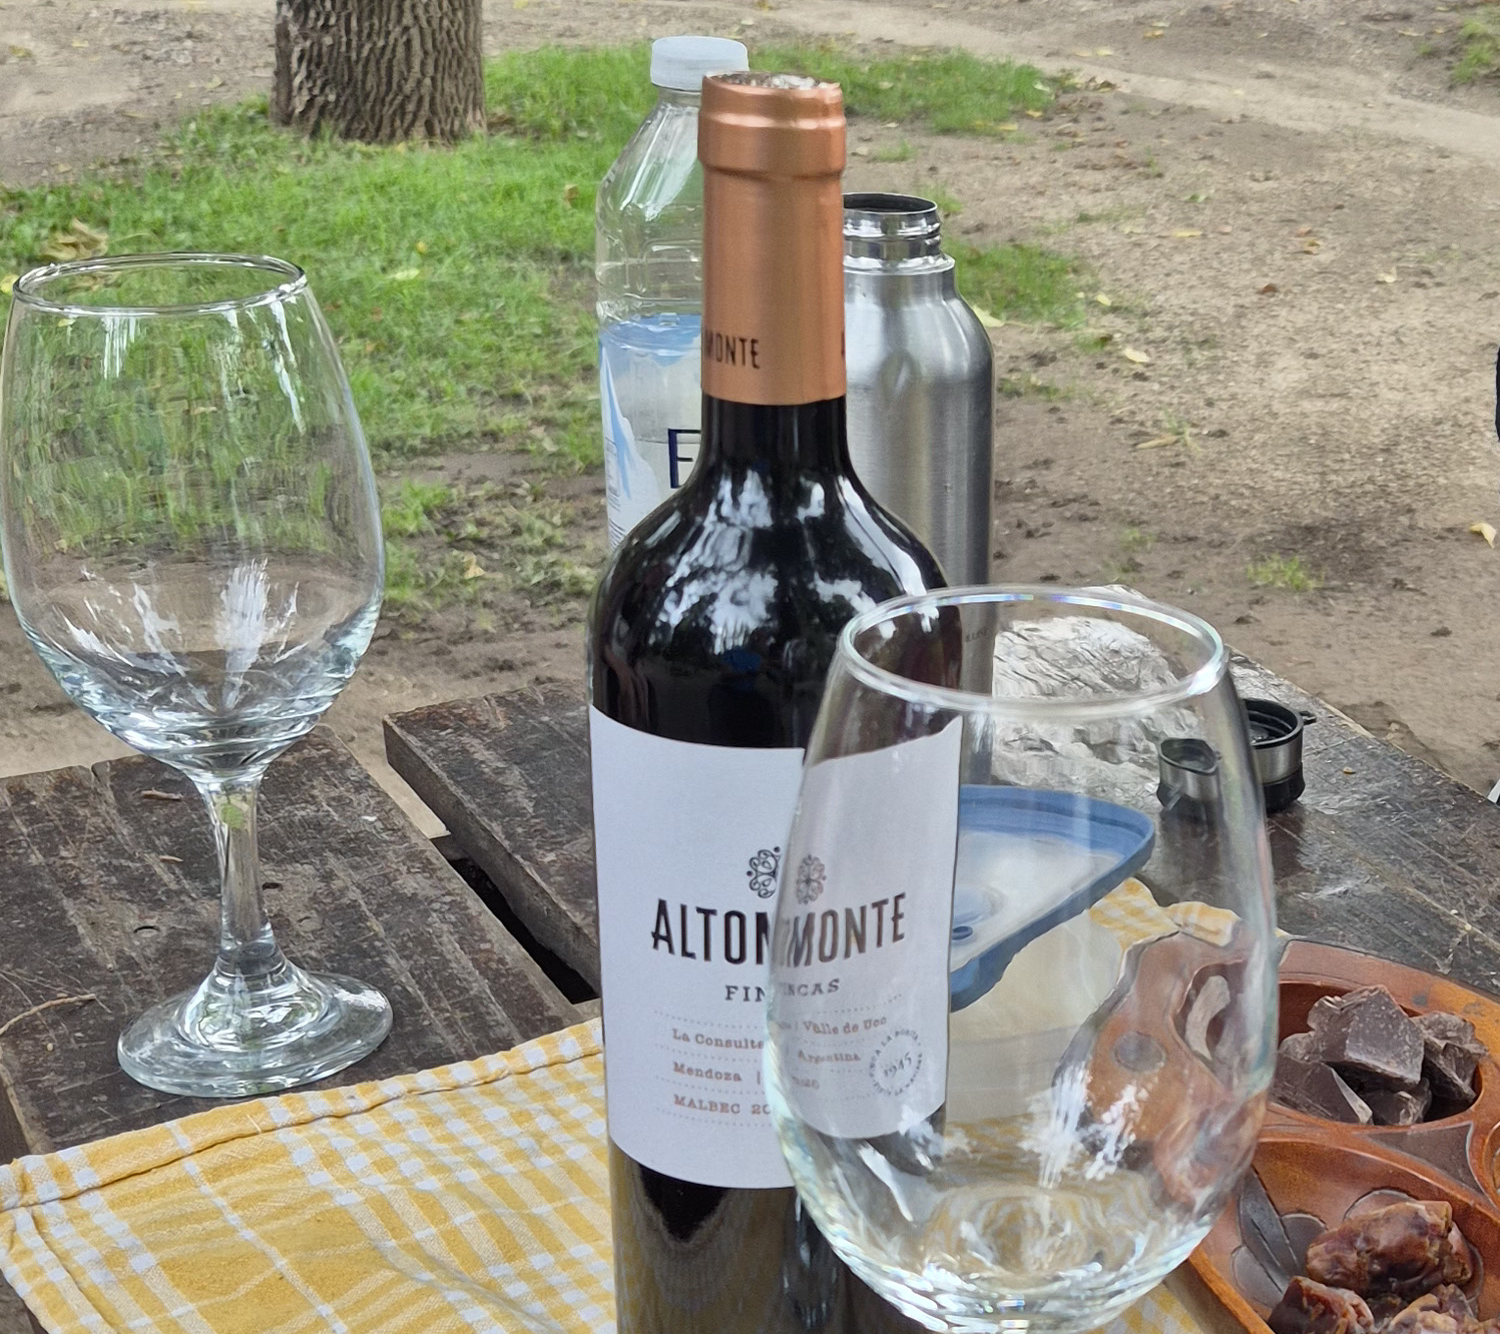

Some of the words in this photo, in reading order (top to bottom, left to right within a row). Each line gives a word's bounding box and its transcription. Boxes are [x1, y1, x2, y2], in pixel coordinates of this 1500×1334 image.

[672, 1028, 691, 1043] La
[673, 1061, 742, 1082] Mendoza
[673, 1094, 741, 1114] MALBEC
